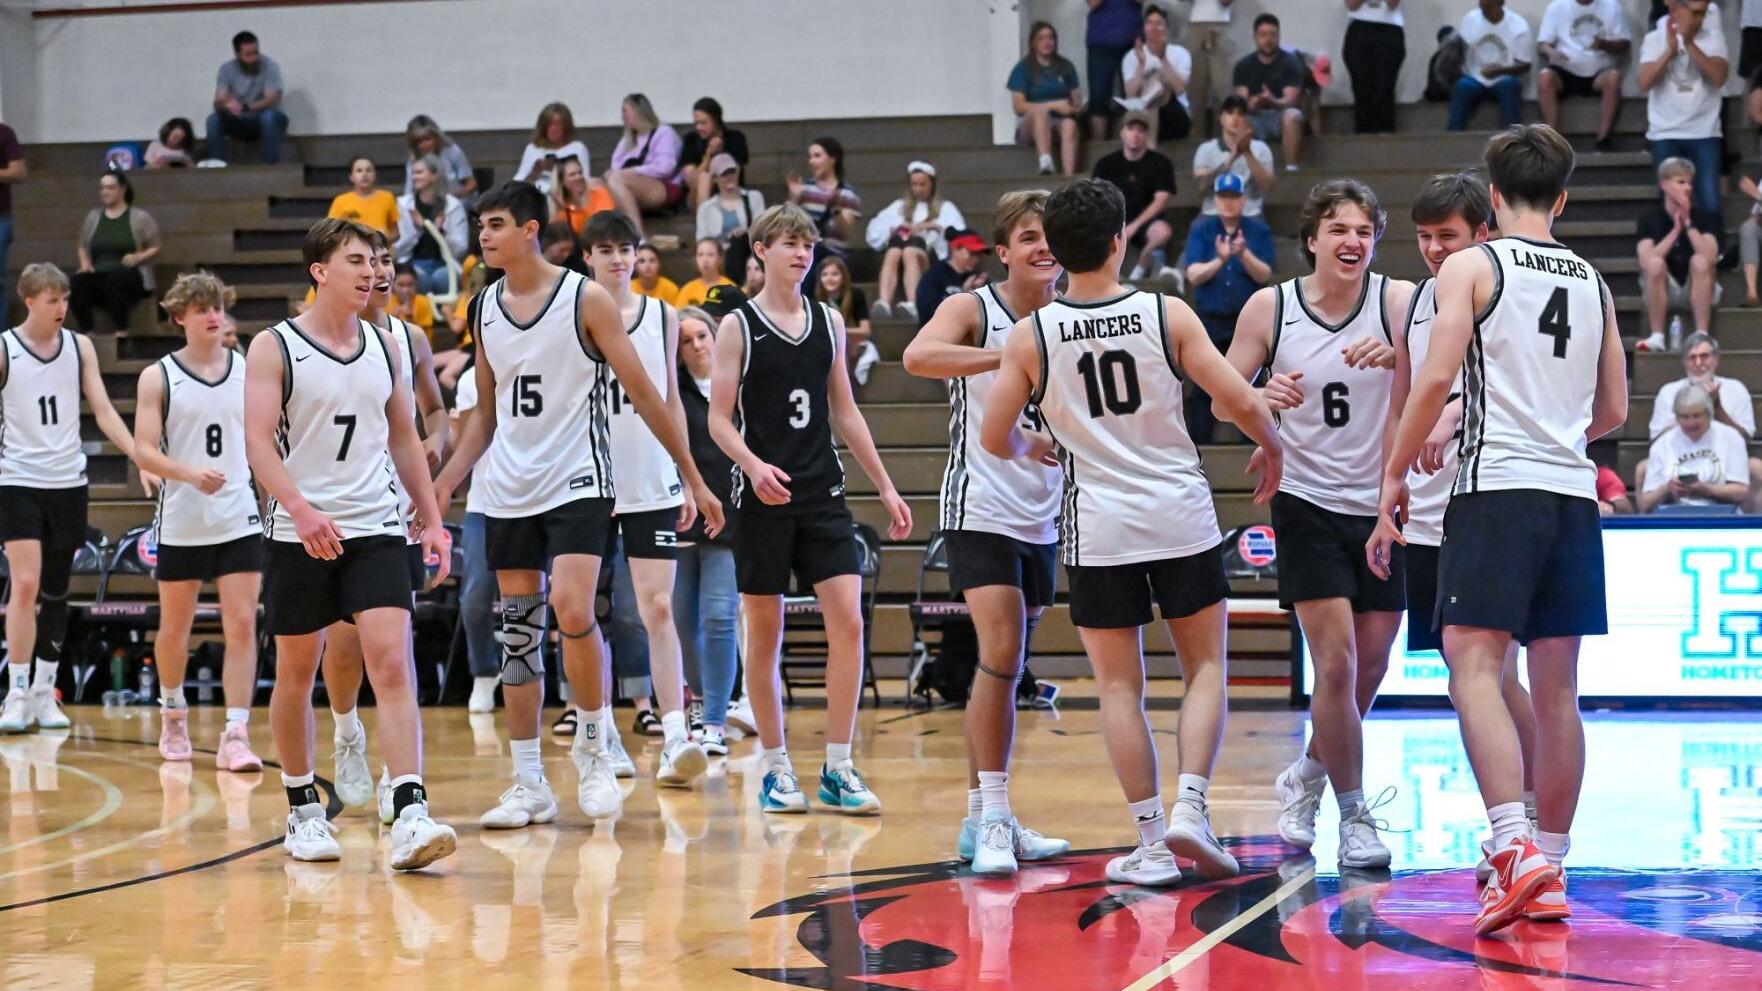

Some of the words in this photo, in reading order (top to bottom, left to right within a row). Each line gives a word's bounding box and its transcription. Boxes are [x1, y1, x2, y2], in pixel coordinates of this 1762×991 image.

[1510, 248, 1589, 281] LANCERS
[1058, 313, 1143, 343] LANCERS
[1537, 286, 1572, 360] 4
[511, 374, 544, 418] 15
[1077, 349, 1142, 419] 10
[1321, 381, 1351, 429] 6
[38, 395, 59, 426] 11
[788, 389, 811, 430] 3
[205, 423, 223, 458] 8
[332, 414, 357, 462] 7
